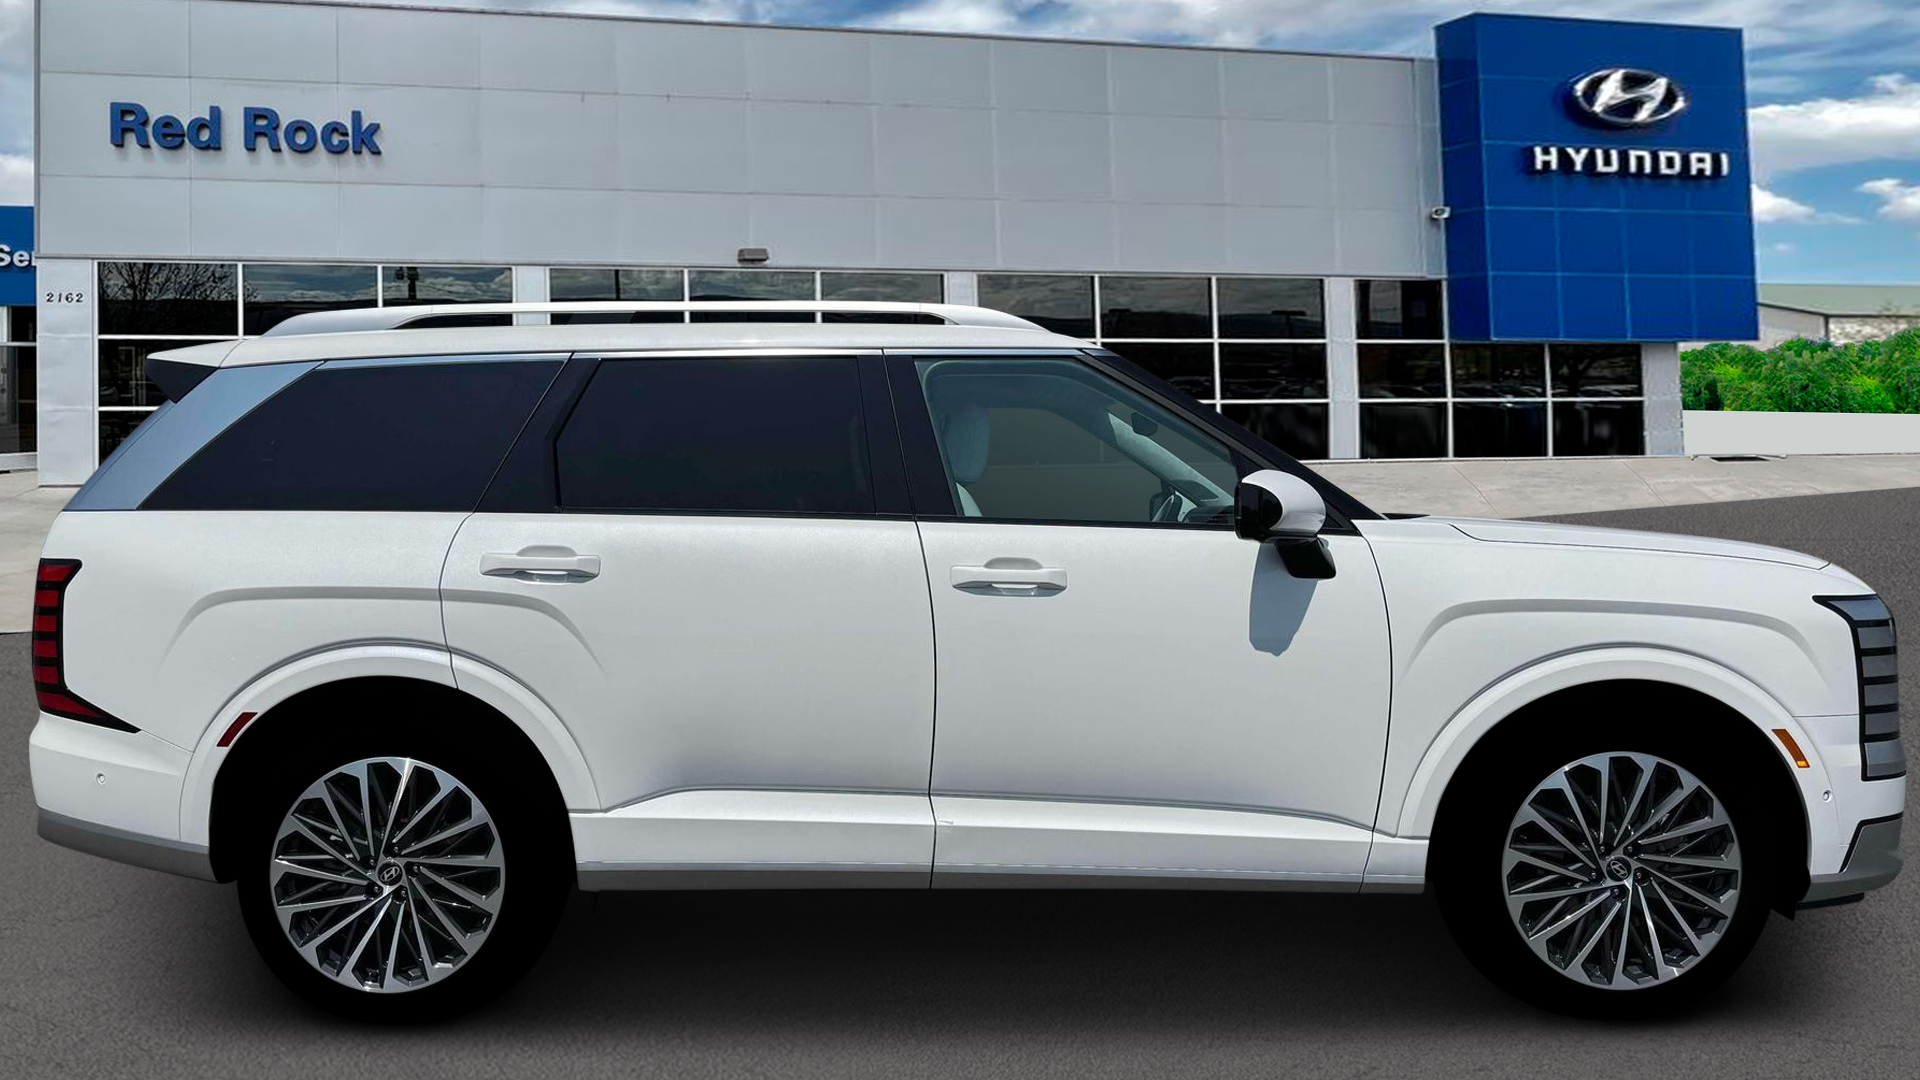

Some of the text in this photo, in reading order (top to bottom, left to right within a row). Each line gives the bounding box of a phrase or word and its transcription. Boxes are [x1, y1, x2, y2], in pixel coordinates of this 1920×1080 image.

[110, 102, 382, 155] Red Rock
[1533, 146, 1729, 177] HYUNDAI
[46, 292, 84, 303] 2162
